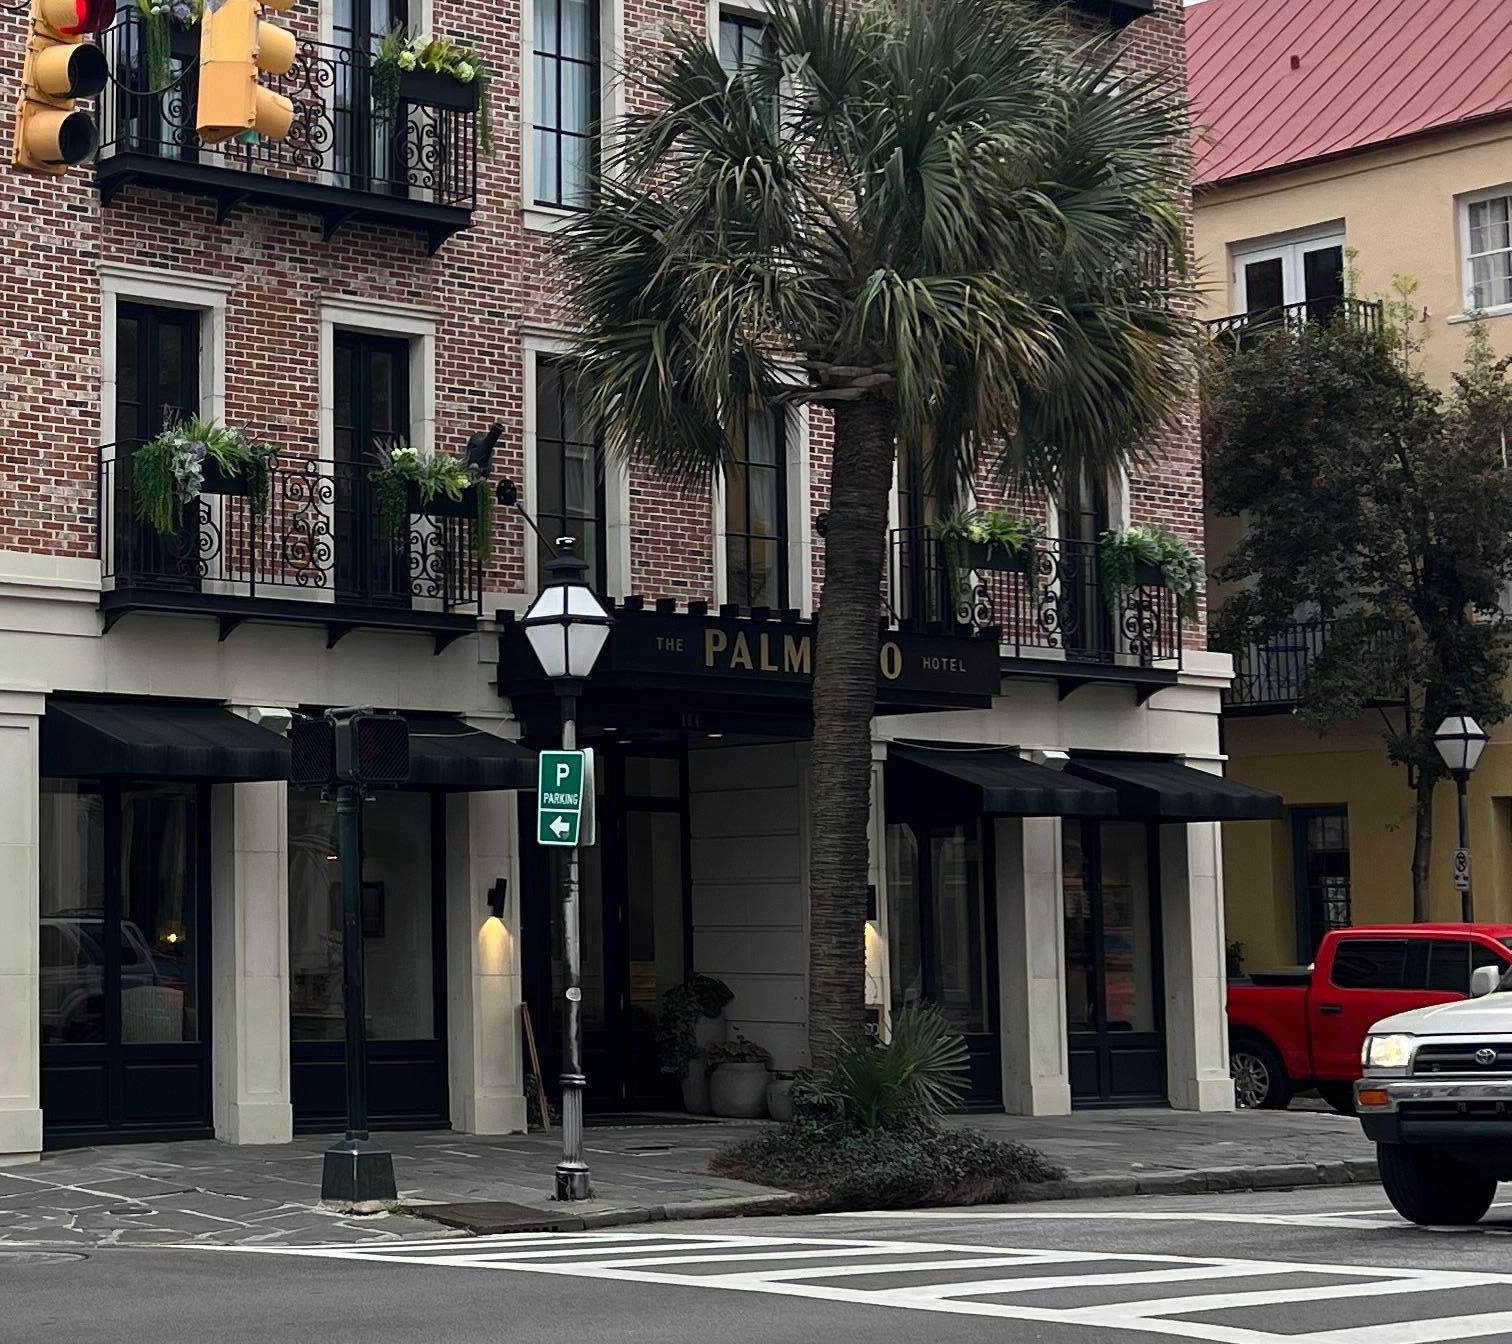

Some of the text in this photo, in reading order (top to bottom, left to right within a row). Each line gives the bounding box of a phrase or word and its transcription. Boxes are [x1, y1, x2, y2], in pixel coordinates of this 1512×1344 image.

[656, 628, 966, 680] THE PALMO HOTEL
[556, 763, 570, 787] P
[543, 792, 579, 805] PARKING
